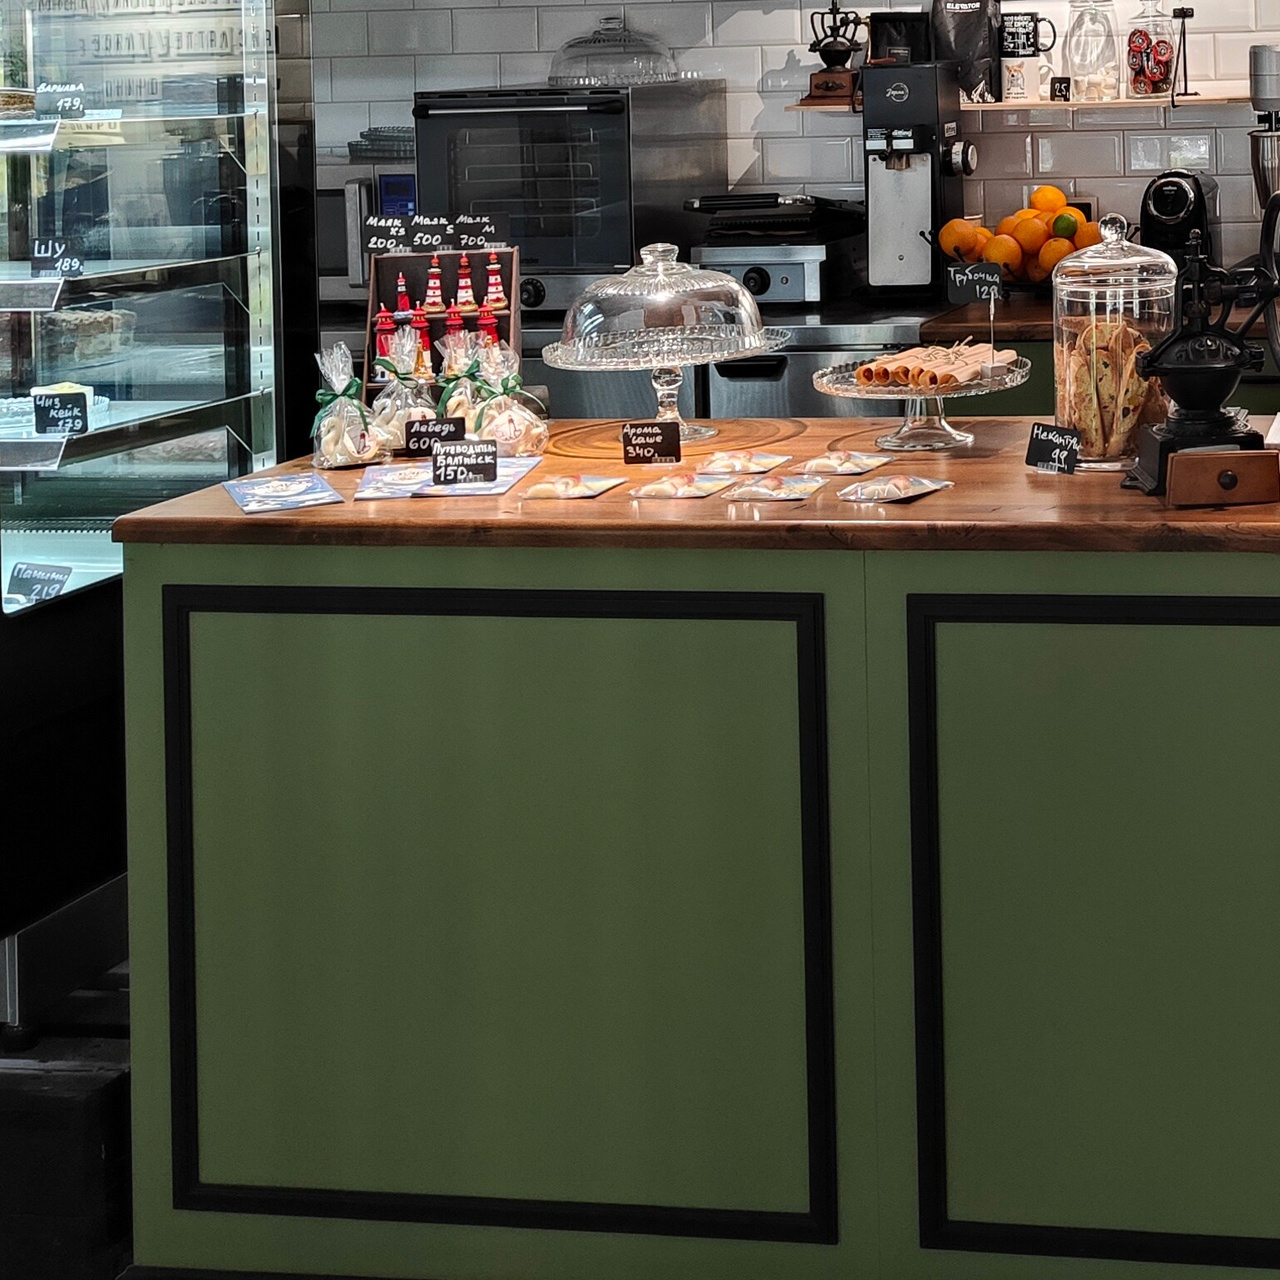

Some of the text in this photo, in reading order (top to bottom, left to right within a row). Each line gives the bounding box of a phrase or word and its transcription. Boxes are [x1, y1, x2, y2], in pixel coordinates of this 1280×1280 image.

[947, 263, 1000, 287] Трубочка
[57, 418, 83, 434] 179
[410, 421, 456, 437] Лебедь
[623, 423, 662, 439] Арома
[30, 583, 60, 600] 219
